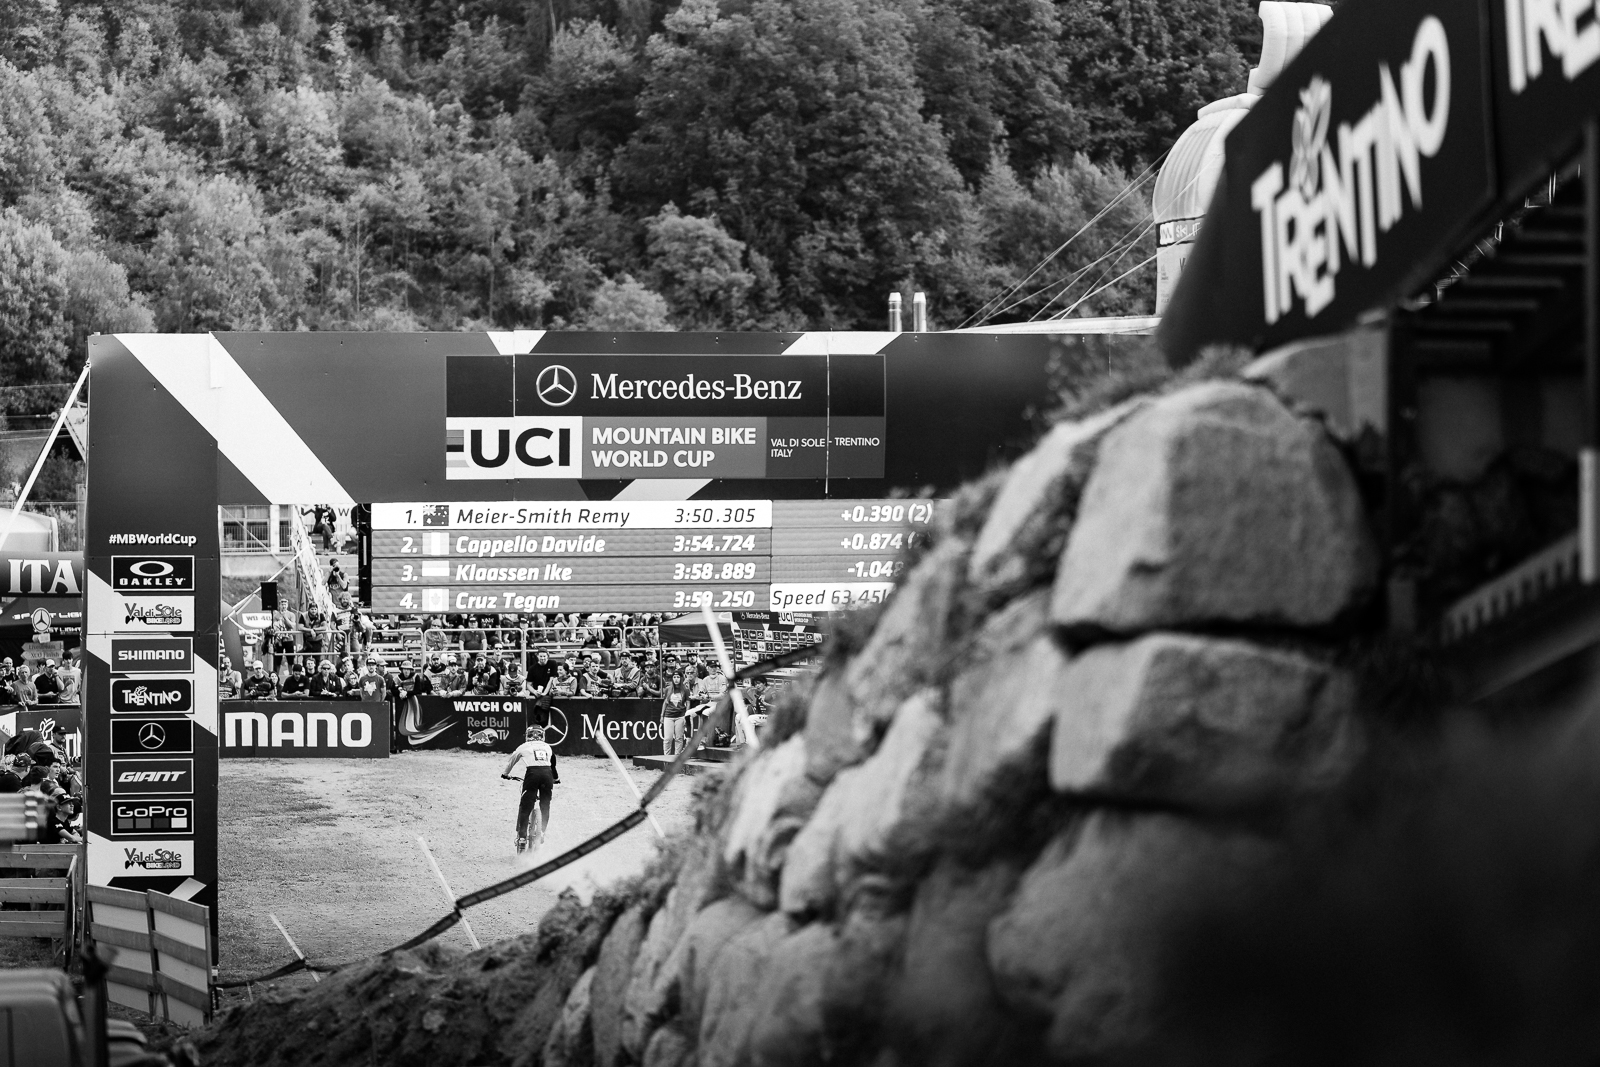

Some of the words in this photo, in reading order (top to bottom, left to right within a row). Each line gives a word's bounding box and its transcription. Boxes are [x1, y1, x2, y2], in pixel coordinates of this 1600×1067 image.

[1251, 15, 1451, 325] TRENTINO
[590, 373, 802, 401] Mercedes-Benz
[592, 427, 706, 445] MOUNTAIN
[711, 427, 757, 445] BIKE
[770, 438, 788, 447] VAL
[789, 438, 799, 447] DI
[801, 438, 826, 447] SOLE
[834, 437, 880, 446] TRENTINO
[470, 428, 571, 468] UCI
[770, 448, 793, 458] ITALY
[591, 450, 668, 468] WORLD
[672, 450, 716, 468] CUP
[405, 509, 418, 524] 1.
[456, 508, 571, 524] Meier-Smith
[578, 508, 630, 527] Remy
[674, 508, 756, 523] 3:50.305
[841, 505, 905, 523] +0.390
[908, 503, 933, 524] (2)
[109, 534, 197, 547] #MBWorldCup
[400, 537, 418, 553] 2.
[455, 535, 538, 558] Cappello
[541, 535, 606, 553] Davide
[672, 535, 756, 552] 3:54.724
[840, 533, 903, 550] +0.874
[401, 565, 418, 582] 3.
[455, 563, 539, 581] Klaassen
[543, 563, 573, 581] Ike
[673, 563, 756, 580] 3:58.889
[119, 578, 186, 586] OAKLEY
[399, 593, 418, 609] 4.
[455, 592, 498, 609] Cruz
[502, 592, 560, 613] Tegan
[673, 590, 755, 608] 3:59.250
[772, 589, 826, 609] Speed
[124, 602, 143, 617] Val
[145, 608, 154, 617] di
[154, 603, 182, 617] Sole
[118, 650, 185, 660] SHIMANO
[122, 688, 182, 706] TRENTINO
[453, 701, 500, 712] WATCH
[502, 701, 522, 712] ON
[224, 712, 372, 748] MANO
[467, 717, 491, 727] Red
[489, 717, 509, 728] Bull
[498, 730, 510, 740] TV
[118, 771, 187, 782] GIANT
[117, 806, 188, 817] GoPro
[124, 847, 143, 862] Val
[145, 853, 154, 861] di
[154, 848, 182, 861] Sole
